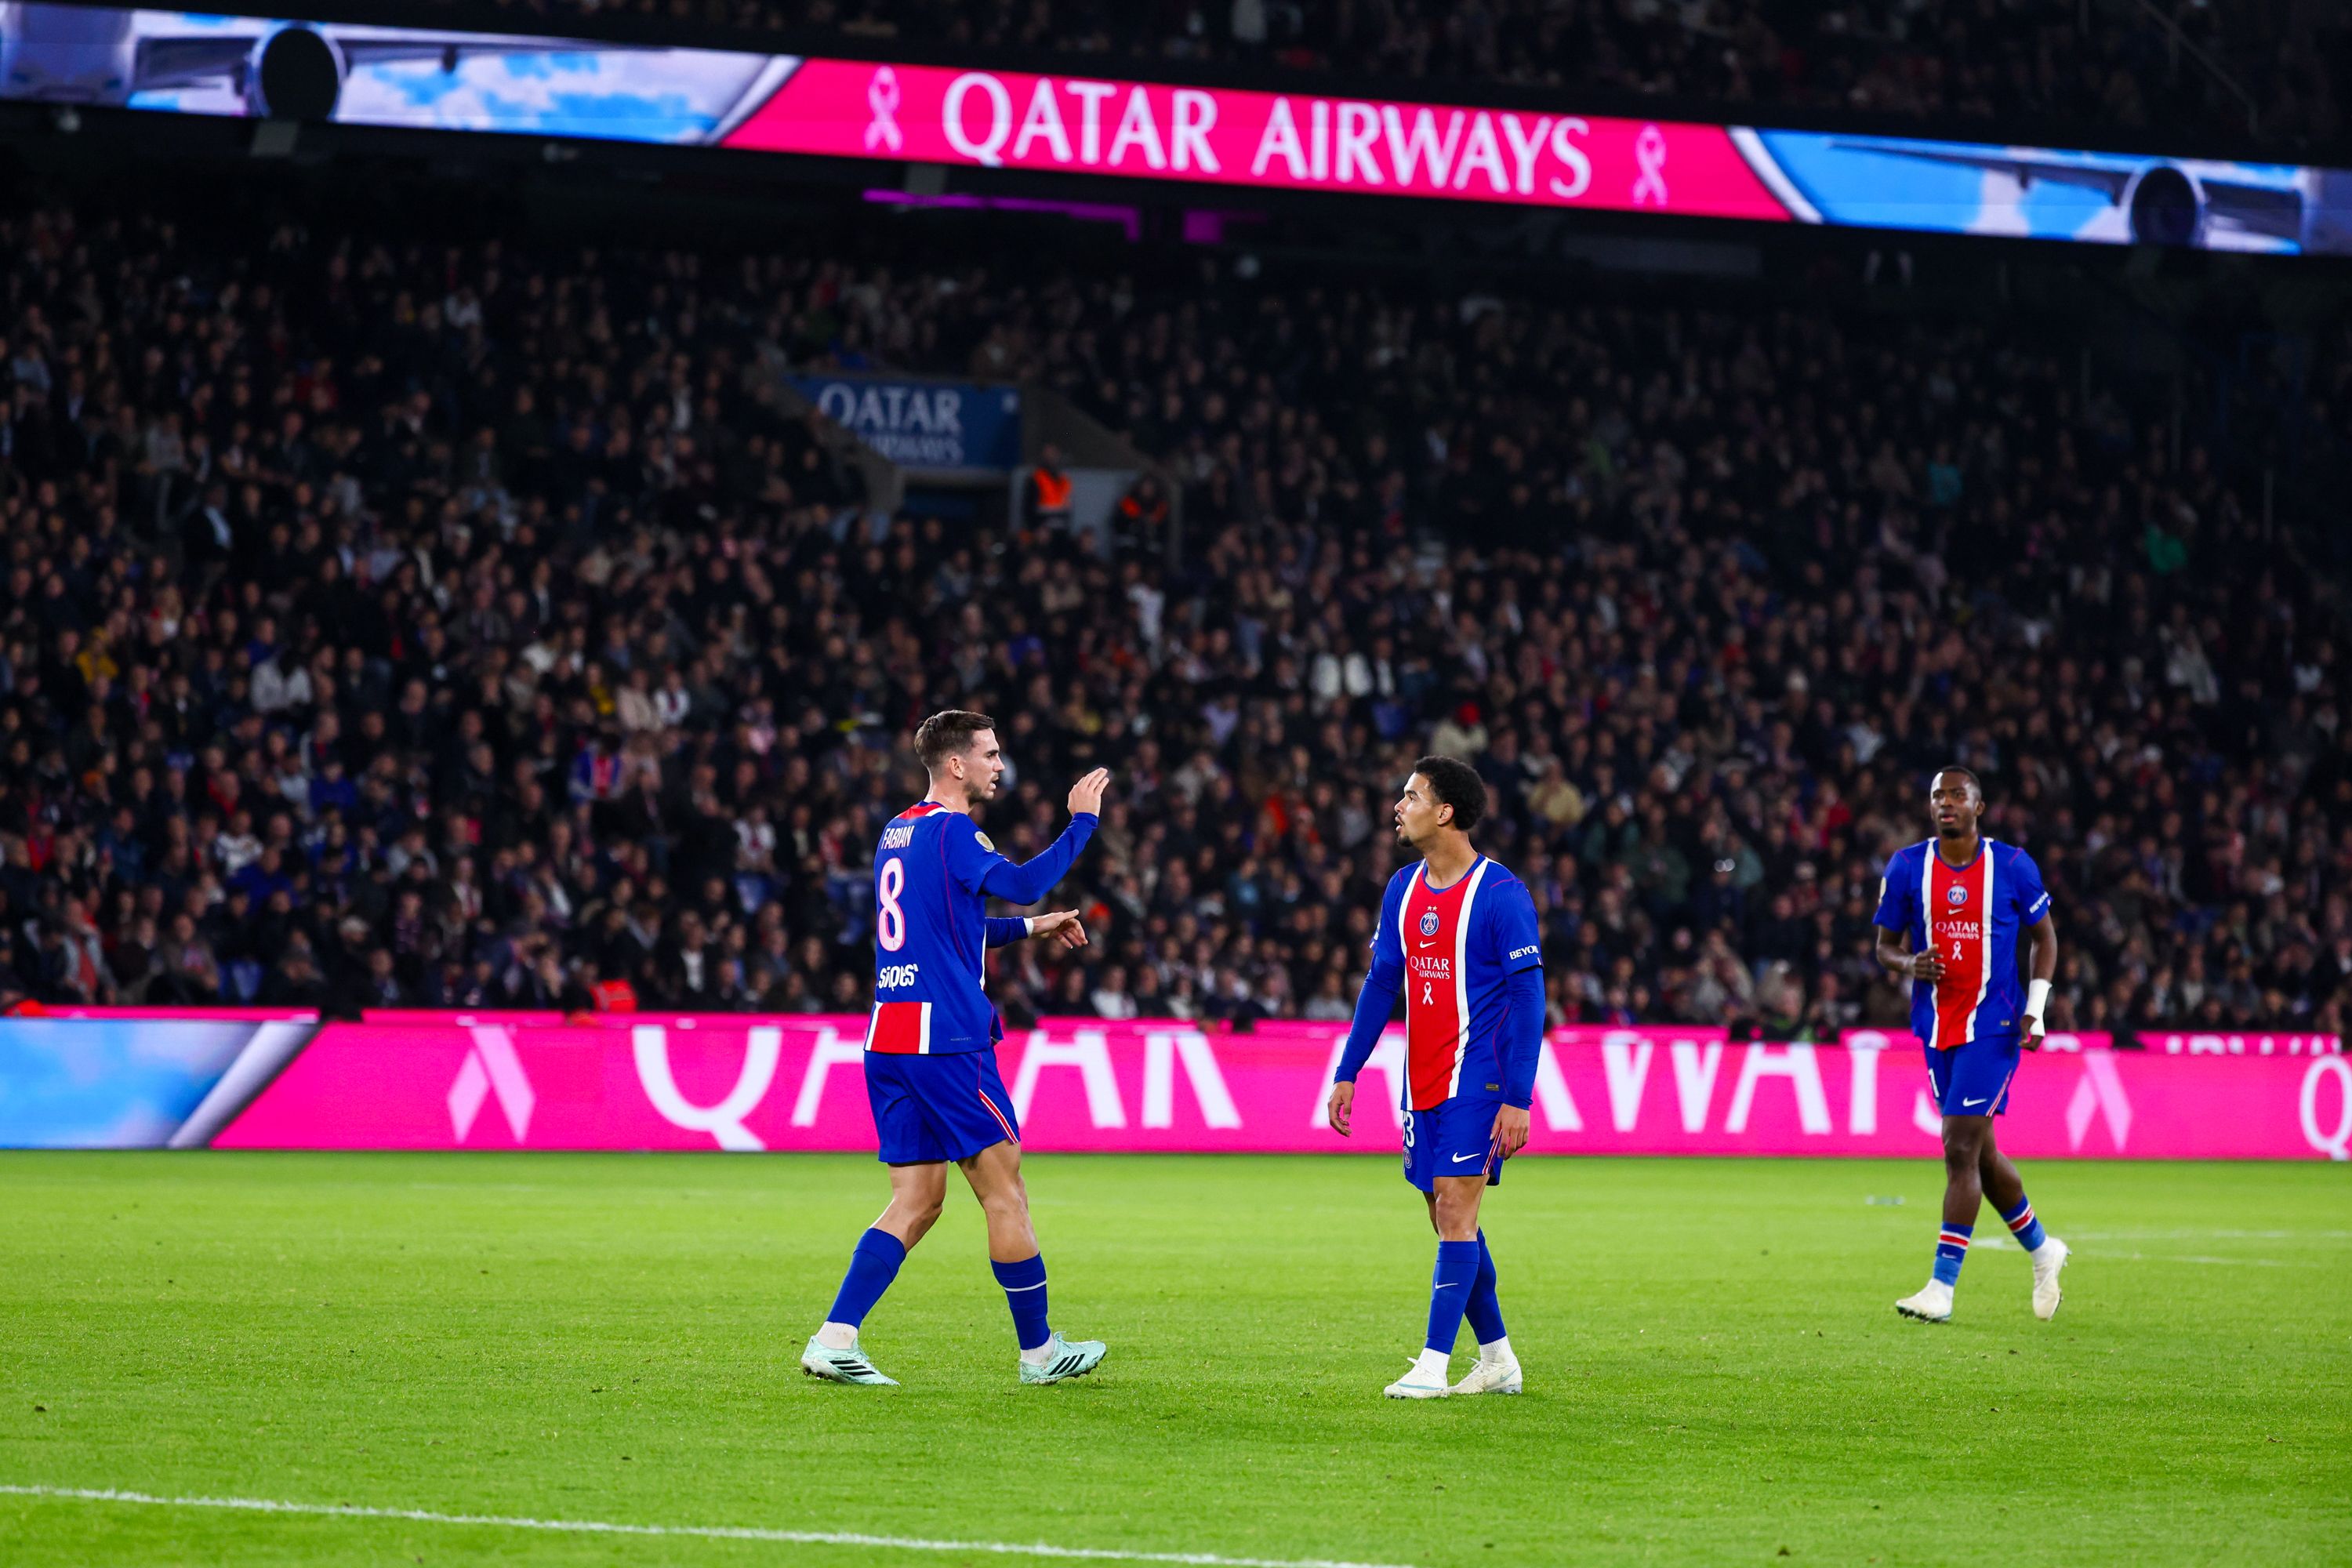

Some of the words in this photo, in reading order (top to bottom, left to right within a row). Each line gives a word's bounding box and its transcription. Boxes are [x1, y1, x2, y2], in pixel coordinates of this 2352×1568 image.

[942, 71, 1221, 175] QATAR
[1250, 96, 1592, 198] AIRWAYS
[880, 825, 915, 850] FABIAN
[878, 857, 906, 952] 8
[1936, 920, 1980, 933] QATAR
[1410, 955, 1450, 971] QATAR
[1419, 970, 1450, 980] AIRWAYS
[1403, 1110, 1415, 1148] 3
